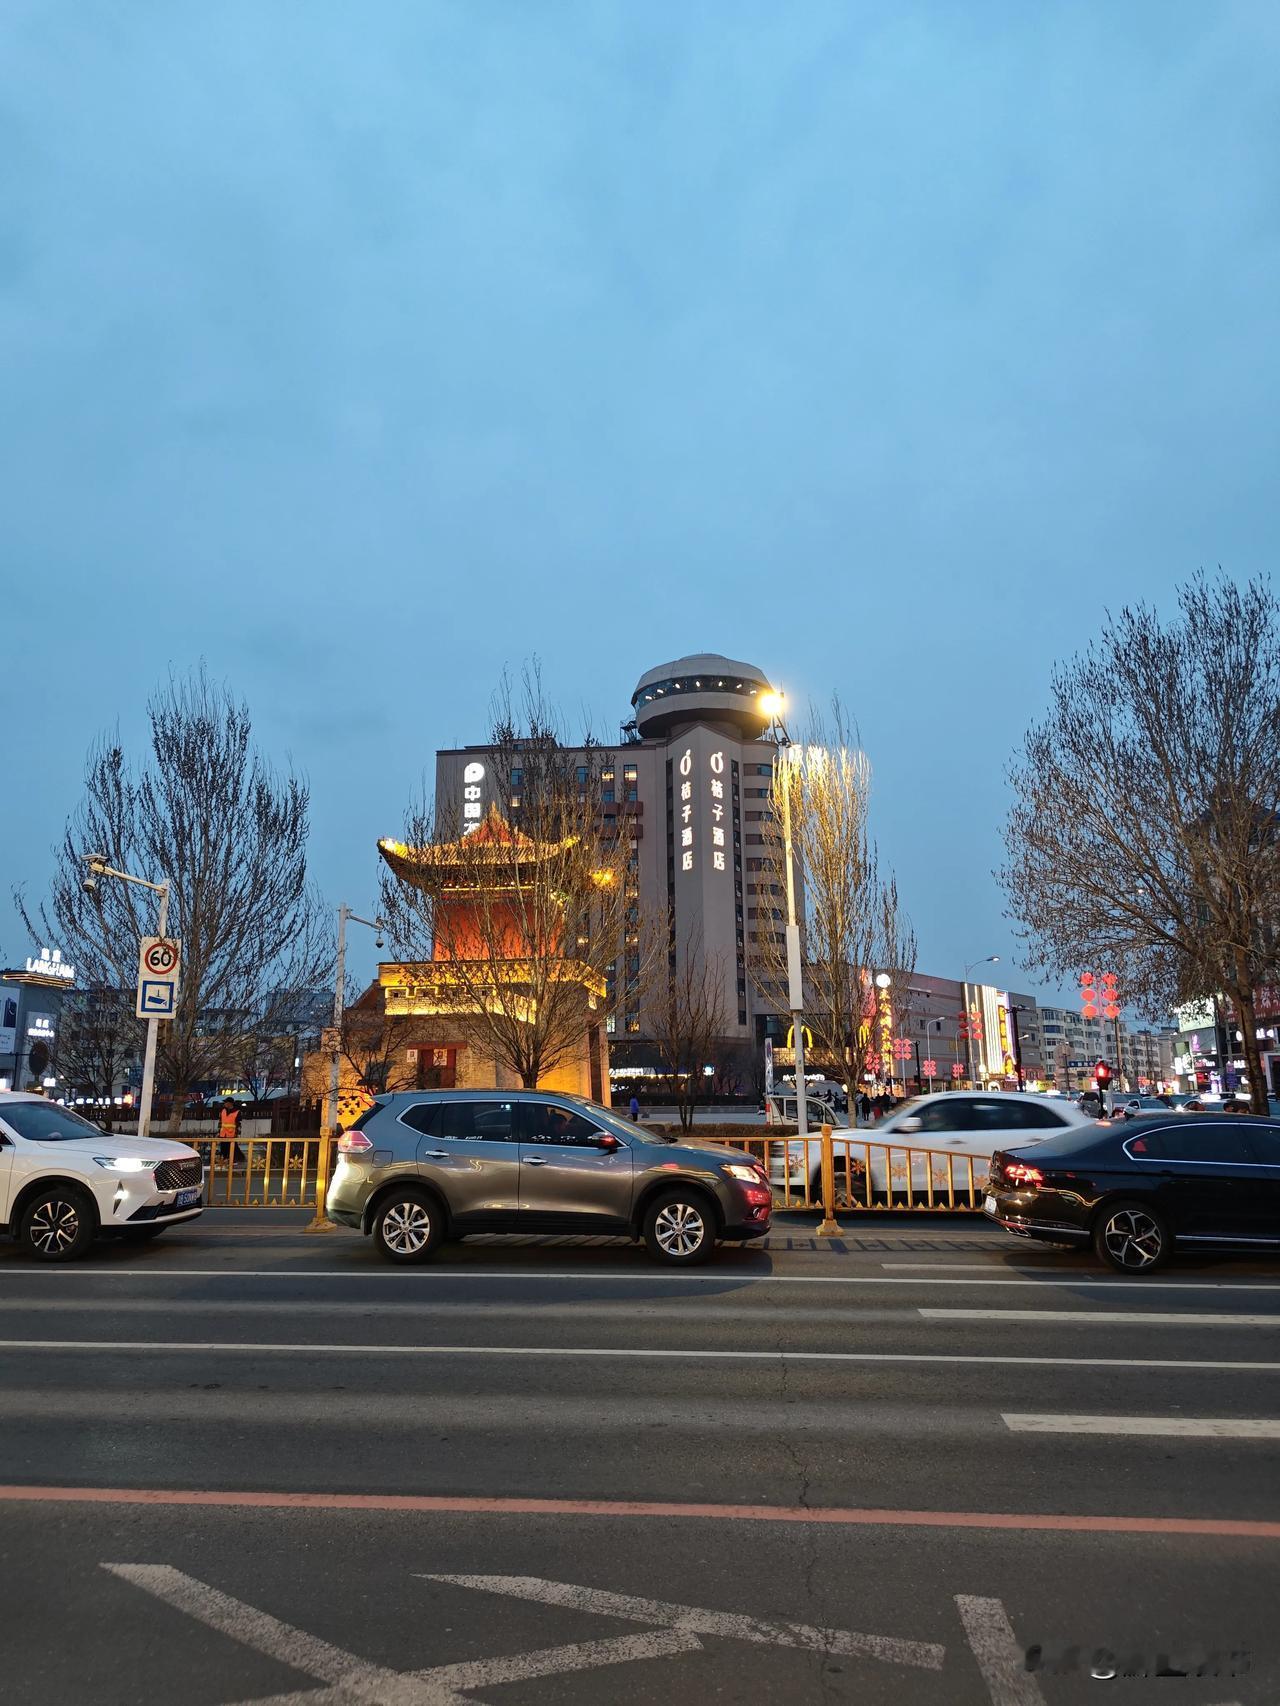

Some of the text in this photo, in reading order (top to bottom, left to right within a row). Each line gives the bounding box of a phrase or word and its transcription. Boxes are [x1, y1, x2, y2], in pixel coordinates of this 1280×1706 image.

[681, 781, 693, 871] 桔子酒店
[711, 779, 725, 871] 桔子酒店
[150, 950, 172, 967] 60
